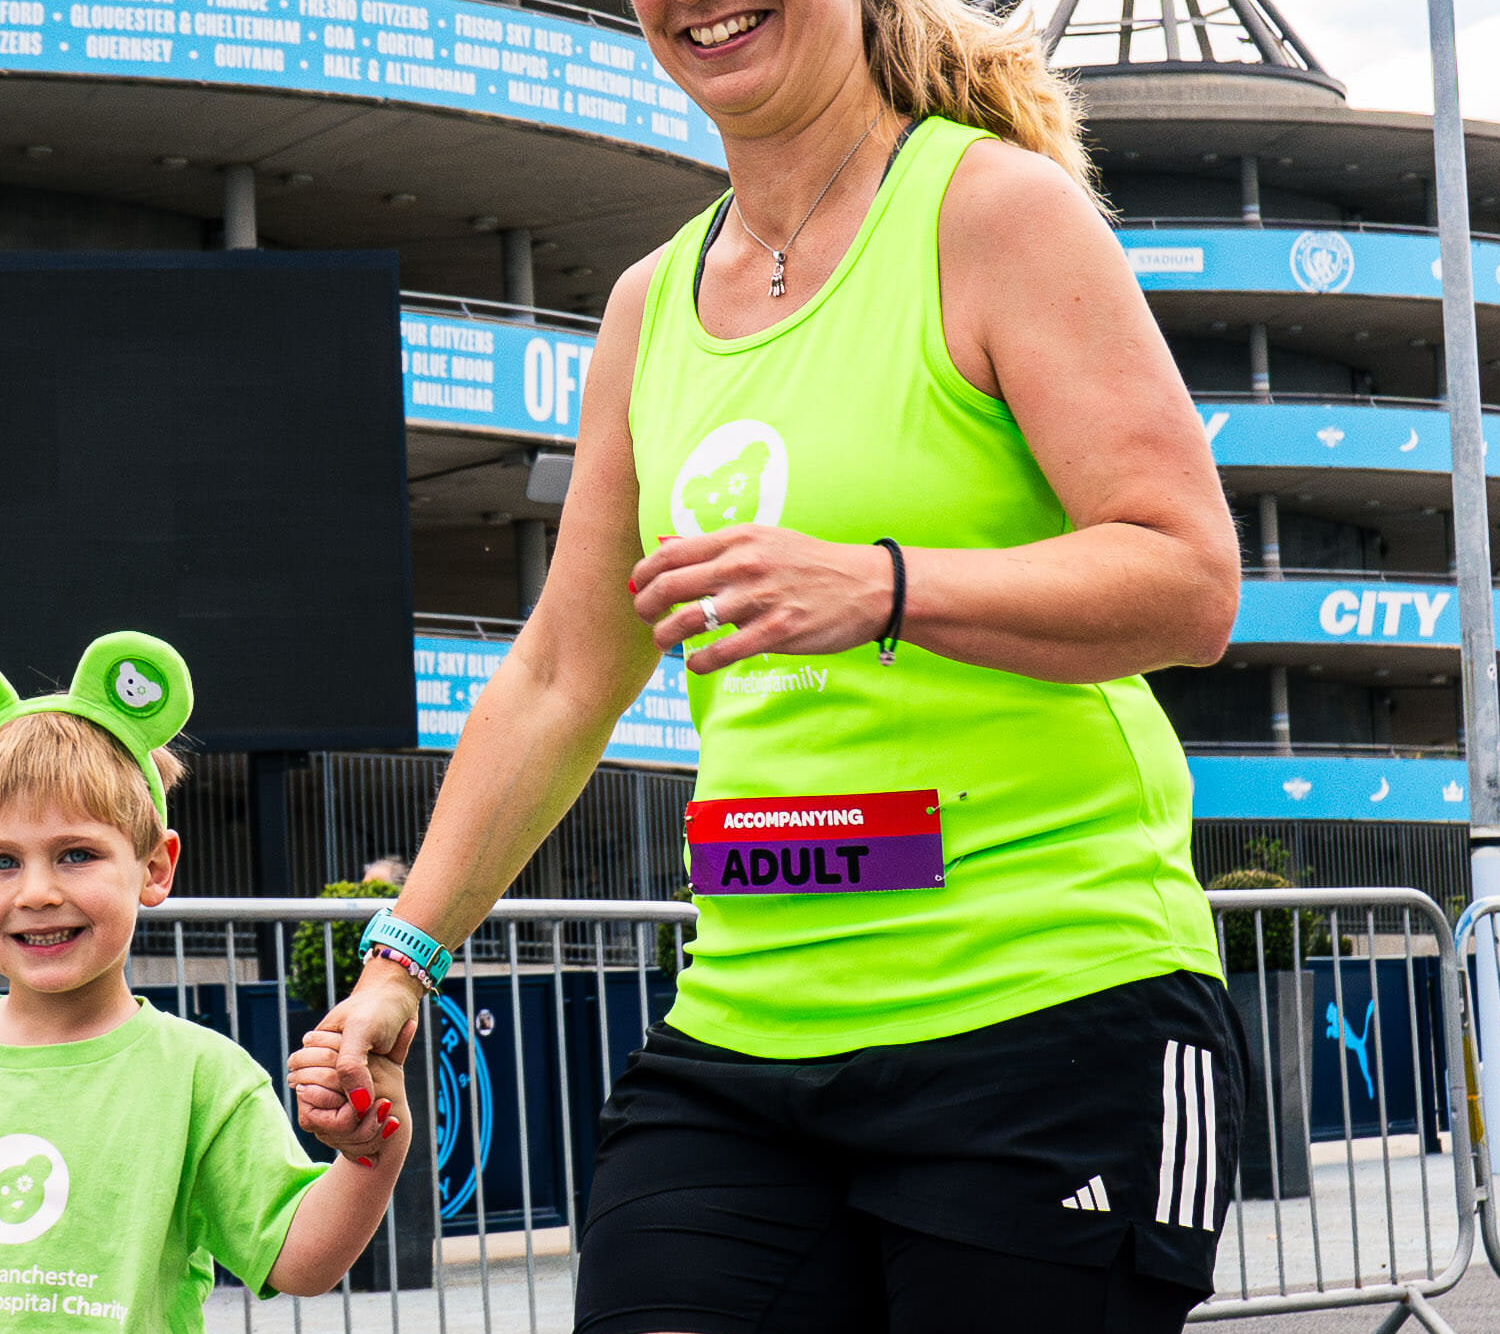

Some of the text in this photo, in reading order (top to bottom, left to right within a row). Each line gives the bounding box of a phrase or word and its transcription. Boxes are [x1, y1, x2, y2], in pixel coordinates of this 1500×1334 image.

[70, 4, 175, 33] GLOUCESTER
[194, 13, 300, 44] CHELTENHAM
[324, 25, 355, 50] GOA
[377, 31, 434, 60] GORTON
[455, 42, 499, 70] GRAND
[502, 51, 548, 80] RAPIDS
[362, 0, 428, 30] CITYZENS
[456, 14, 503, 43] FRISCO
[506, 23, 531, 47] SKY
[535, 28, 572, 56] BLUES
[590, 41, 635, 70] GALWAY
[86, 35, 172, 62] GUERNSEY
[215, 44, 284, 72] GUIYANG
[324, 54, 361, 80] HALE
[386, 61, 476, 95] ALTRINCHAM
[509, 80, 559, 110] HALIFAX
[578, 94, 626, 125] DISTRICT
[1137, 253, 1196, 266] STADIUM
[430, 325, 494, 355] CITYZENS
[412, 352, 448, 378] BLUE
[451, 356, 494, 384] MOON
[412, 380, 494, 414] MULLINGAR
[1319, 588, 1452, 638] CITY
[438, 652, 466, 678] SKY
[722, 665, 828, 700] #onebigfamily
[723, 808, 865, 830] ACCOMPANYING
[720, 845, 870, 887] ADULT
[62, 1295, 130, 1326] Charity
